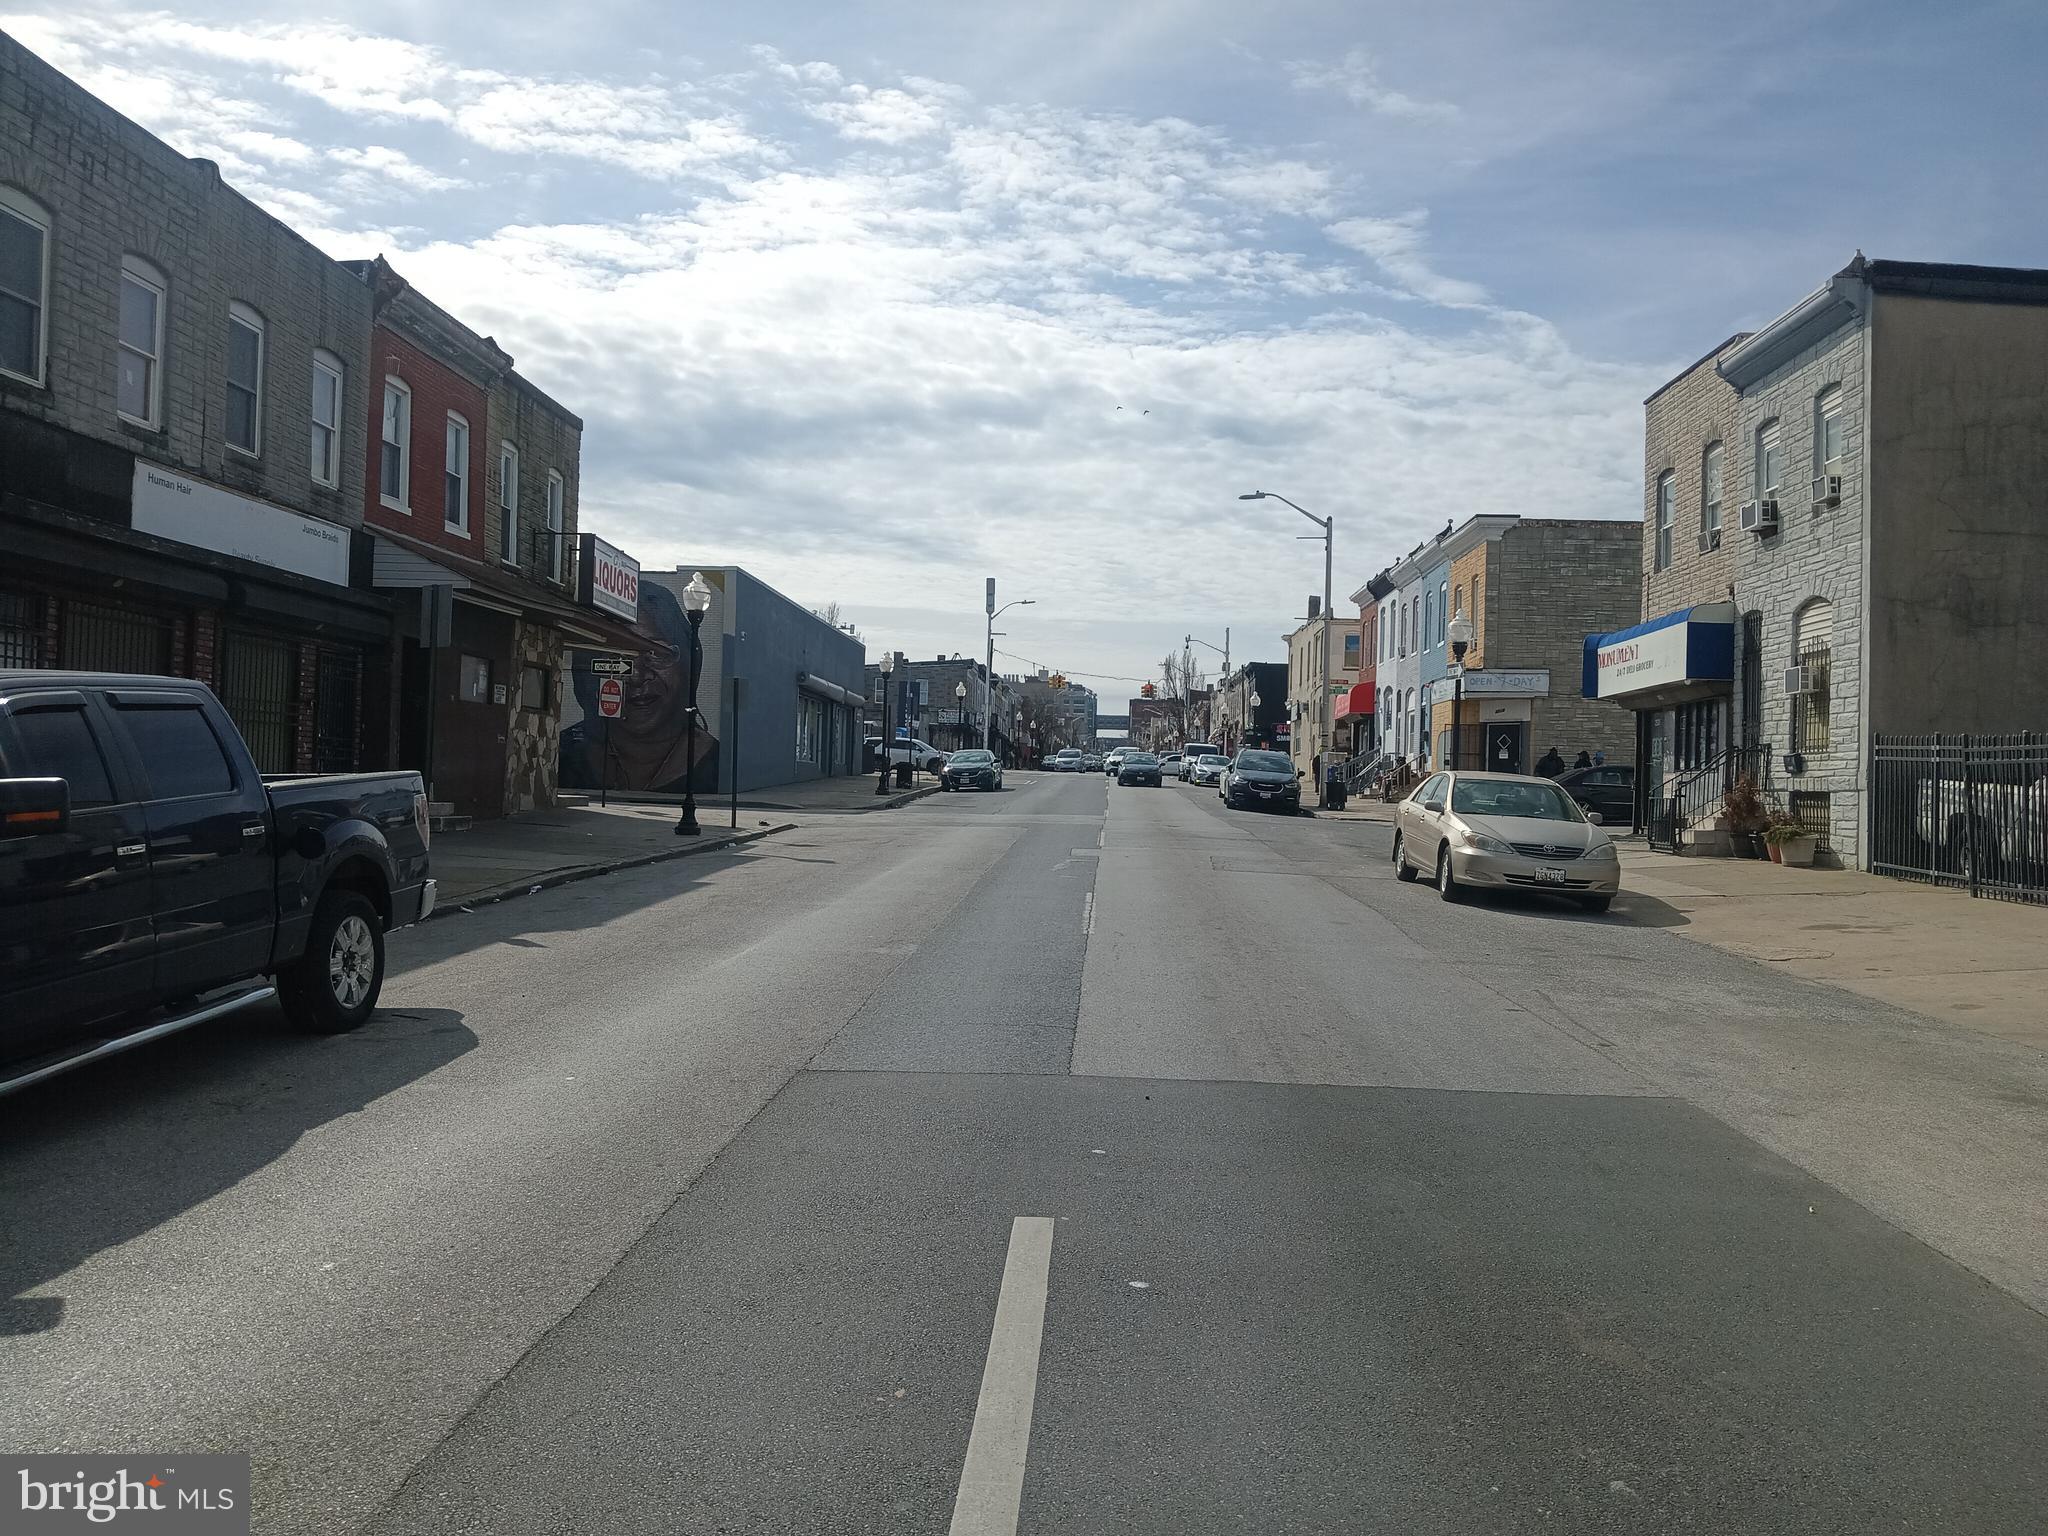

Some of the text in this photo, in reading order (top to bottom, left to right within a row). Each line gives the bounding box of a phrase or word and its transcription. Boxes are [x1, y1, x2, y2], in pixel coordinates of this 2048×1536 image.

[147, 472, 192, 495] Human Hair
[302, 524, 339, 543] Jumbo Braids
[593, 556, 637, 603] LIQUORS
[1598, 644, 1639, 668] MONUMENT
[1636, 660, 1654, 672] GROCERY
[1469, 677, 1492, 686] OPEN
